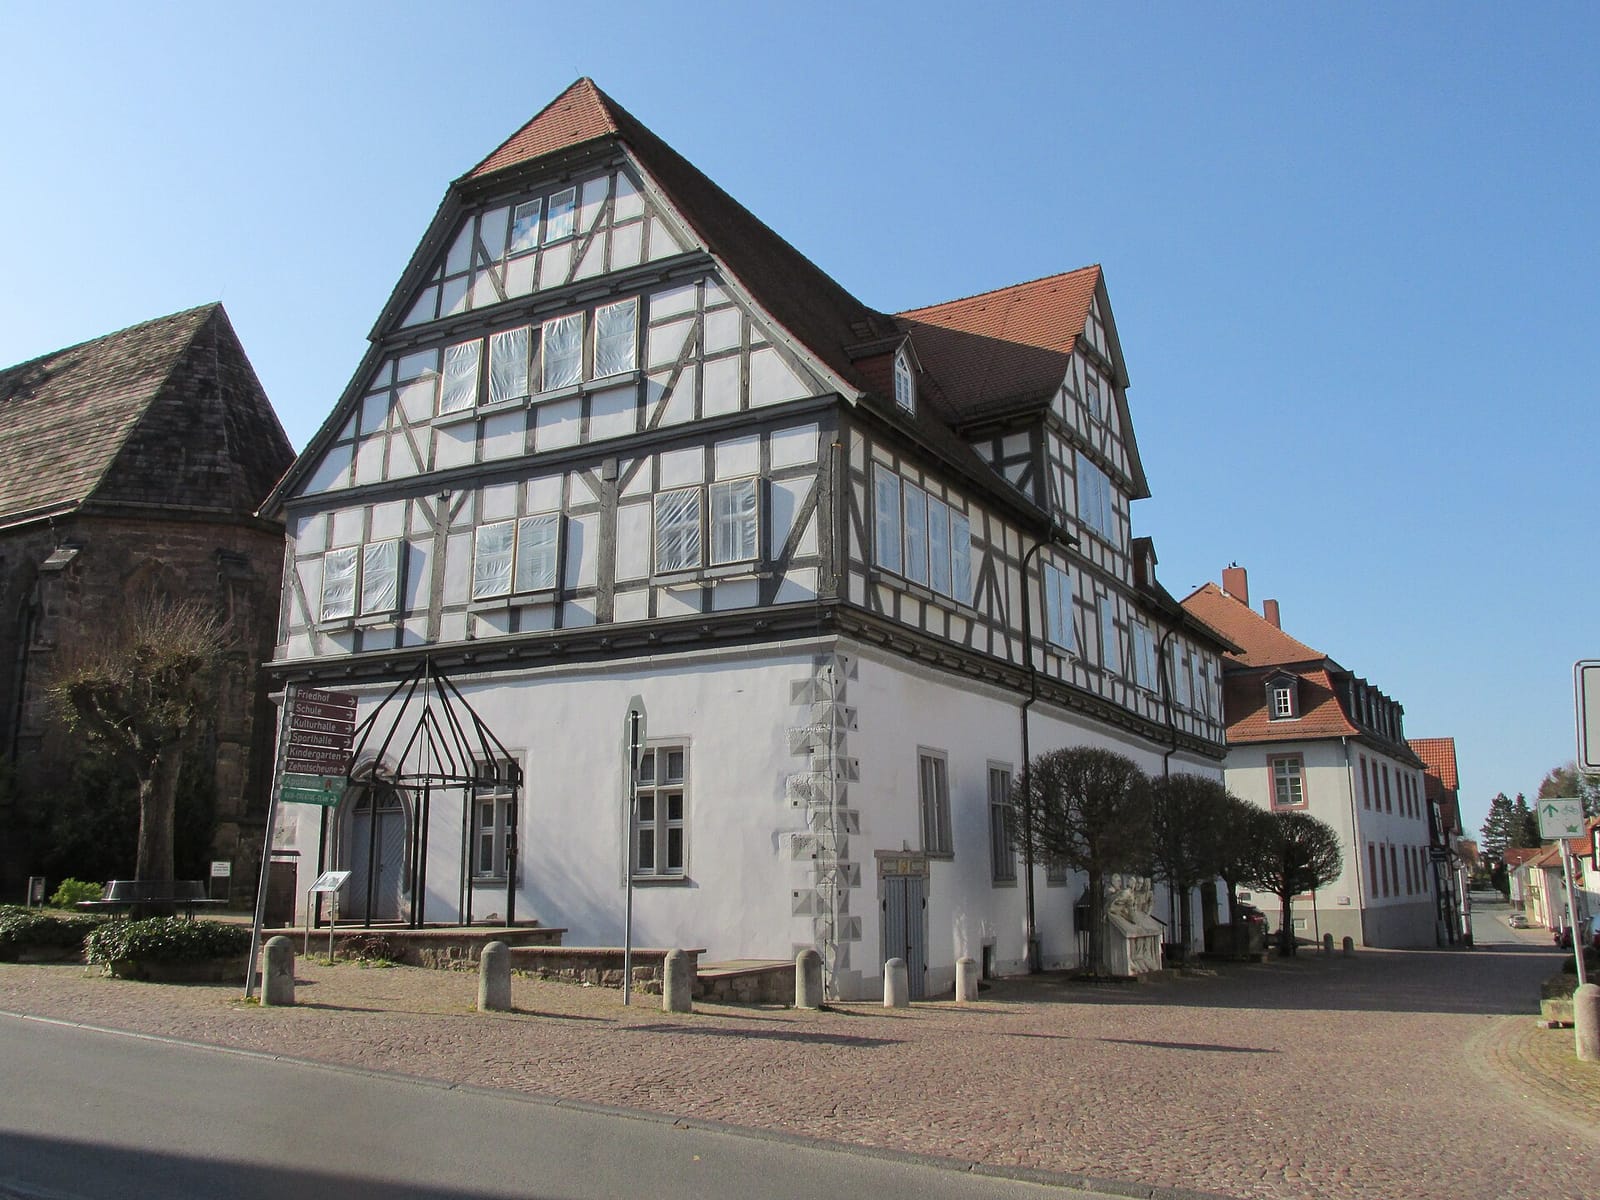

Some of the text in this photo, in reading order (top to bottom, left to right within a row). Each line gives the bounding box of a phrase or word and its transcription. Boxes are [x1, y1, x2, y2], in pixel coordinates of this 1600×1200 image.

[297, 689, 330, 702] Friedhof
[296, 703, 322, 715] Schule
[293, 718, 336, 732] Kulturhalle
[292, 732, 333, 745] Sporthalle
[289, 747, 341, 760] Kindergarten
[288, 761, 338, 773] Zehntscheune
